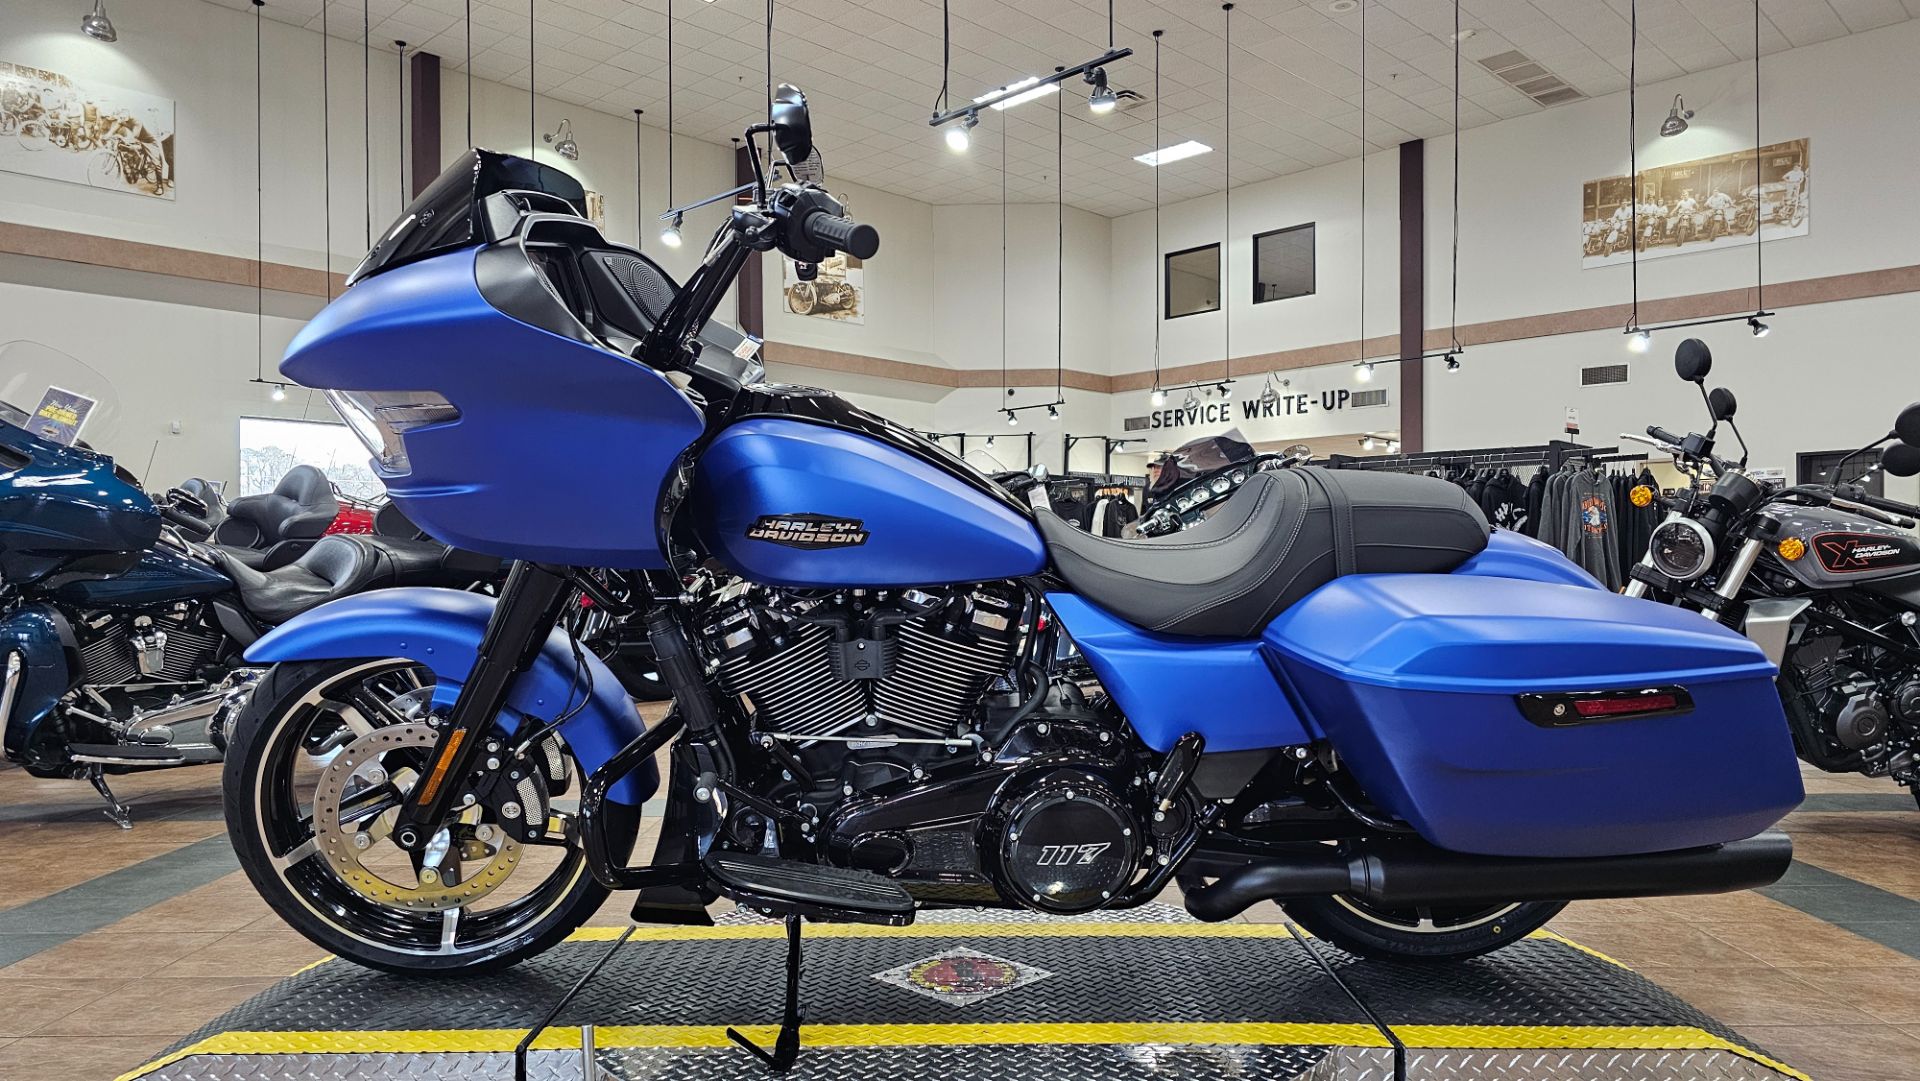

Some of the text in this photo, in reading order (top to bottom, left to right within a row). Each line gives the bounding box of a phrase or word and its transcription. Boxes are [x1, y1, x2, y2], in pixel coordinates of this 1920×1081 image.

[1151, 389, 1350, 428] SERVICE WRITE-UP
[762, 519, 859, 533] HARLEY-
[748, 528, 864, 543] DAVIDSON
[1851, 544, 1892, 554] HARLEY-
[1855, 548, 1901, 559] DAVIDSON
[1036, 842, 1111, 866] 117
